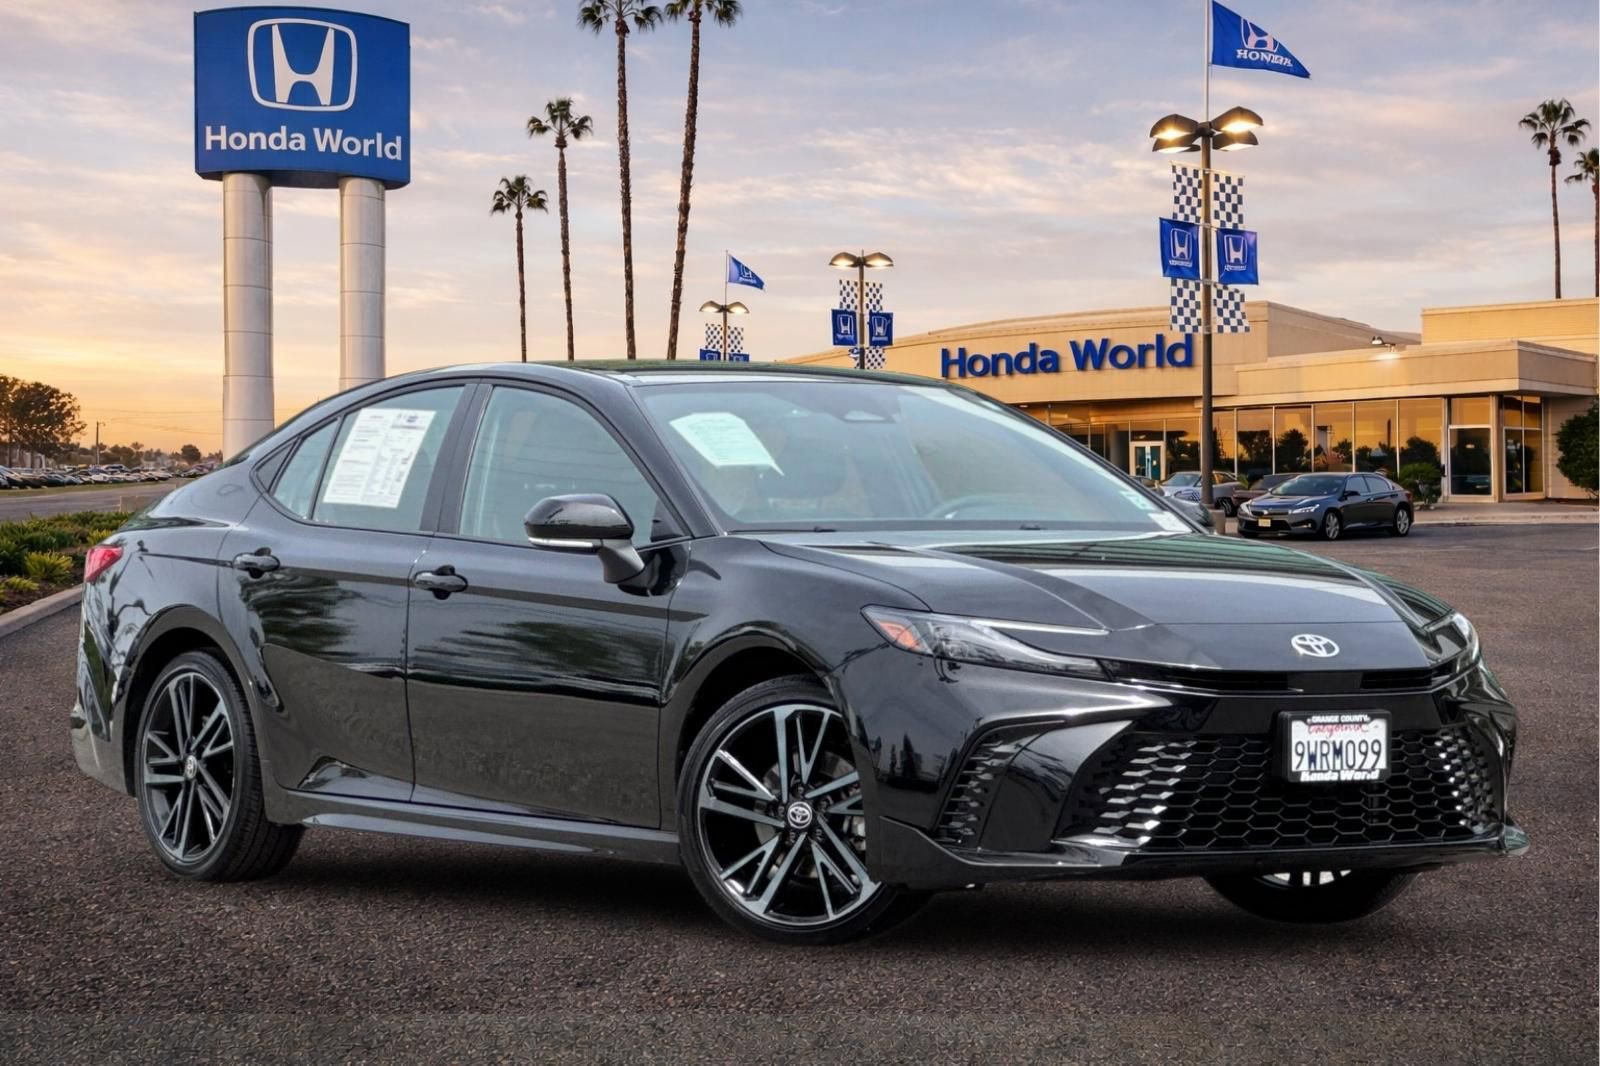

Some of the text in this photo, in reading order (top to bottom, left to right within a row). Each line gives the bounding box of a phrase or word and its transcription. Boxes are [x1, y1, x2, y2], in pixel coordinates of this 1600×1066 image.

[1236, 49, 1293, 67] HONDA
[205, 125, 402, 161] Honda World
[941, 333, 1194, 378] Honda World
[1295, 740, 1382, 770] 9WRM099
